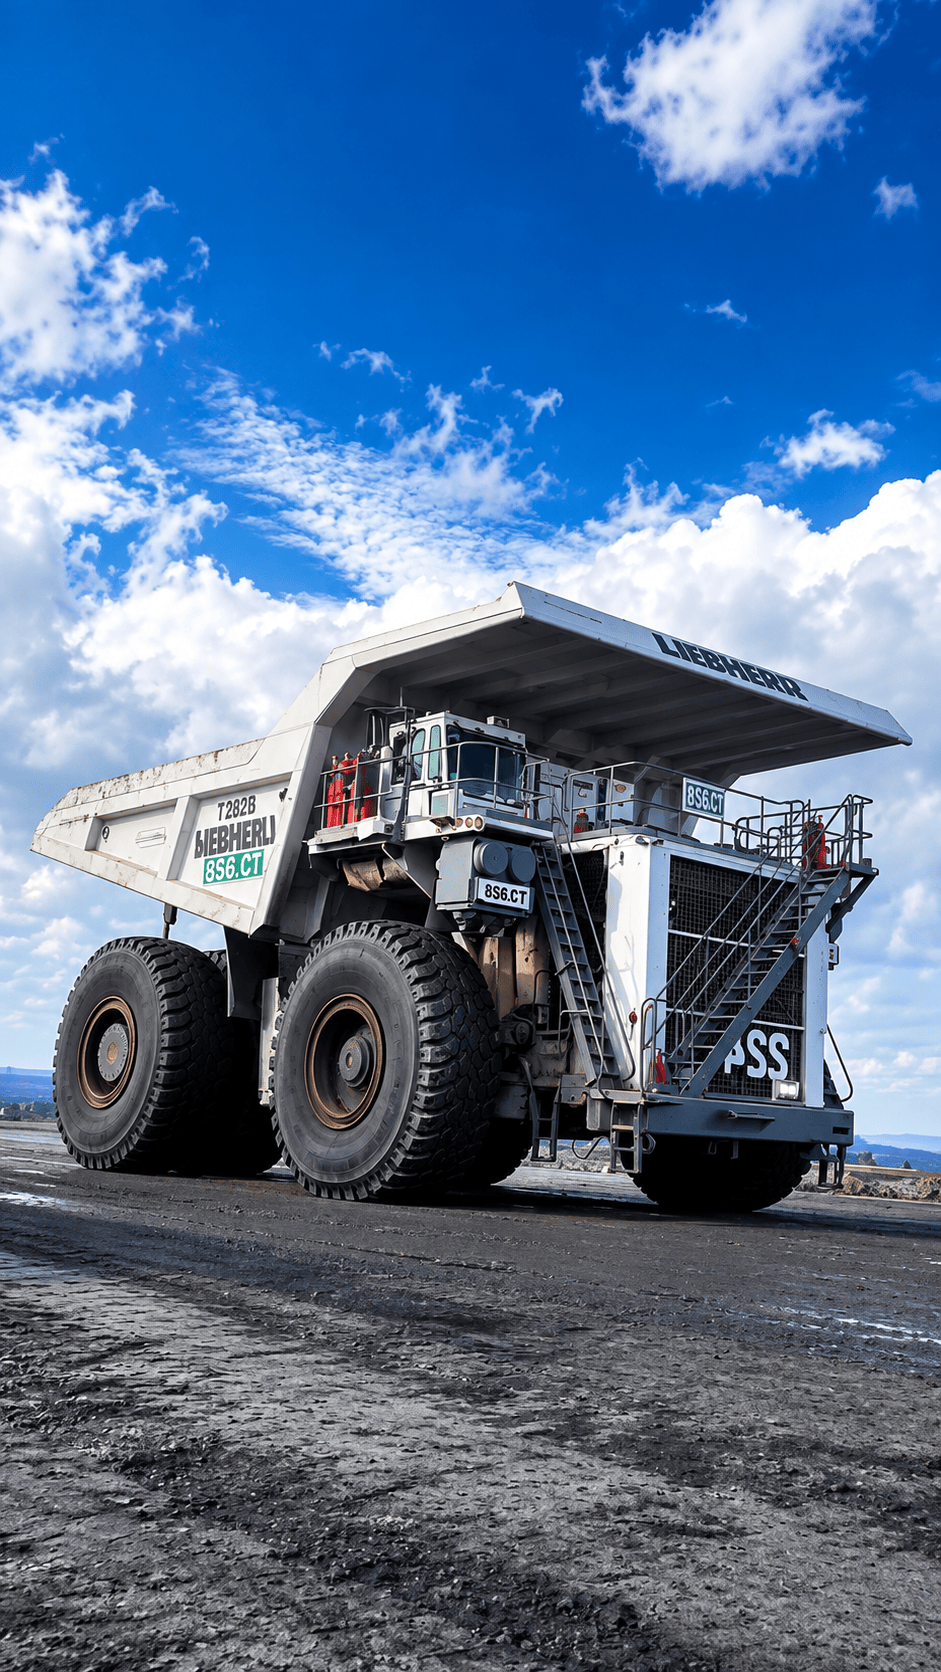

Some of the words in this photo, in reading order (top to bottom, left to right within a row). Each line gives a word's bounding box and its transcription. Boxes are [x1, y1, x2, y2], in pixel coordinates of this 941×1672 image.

[651, 632, 809, 702] LIEBHERR
[217, 795, 256, 821] T282B
[205, 852, 262, 883] 8S6.CT
[484, 883, 527, 905] 8S6.CT
